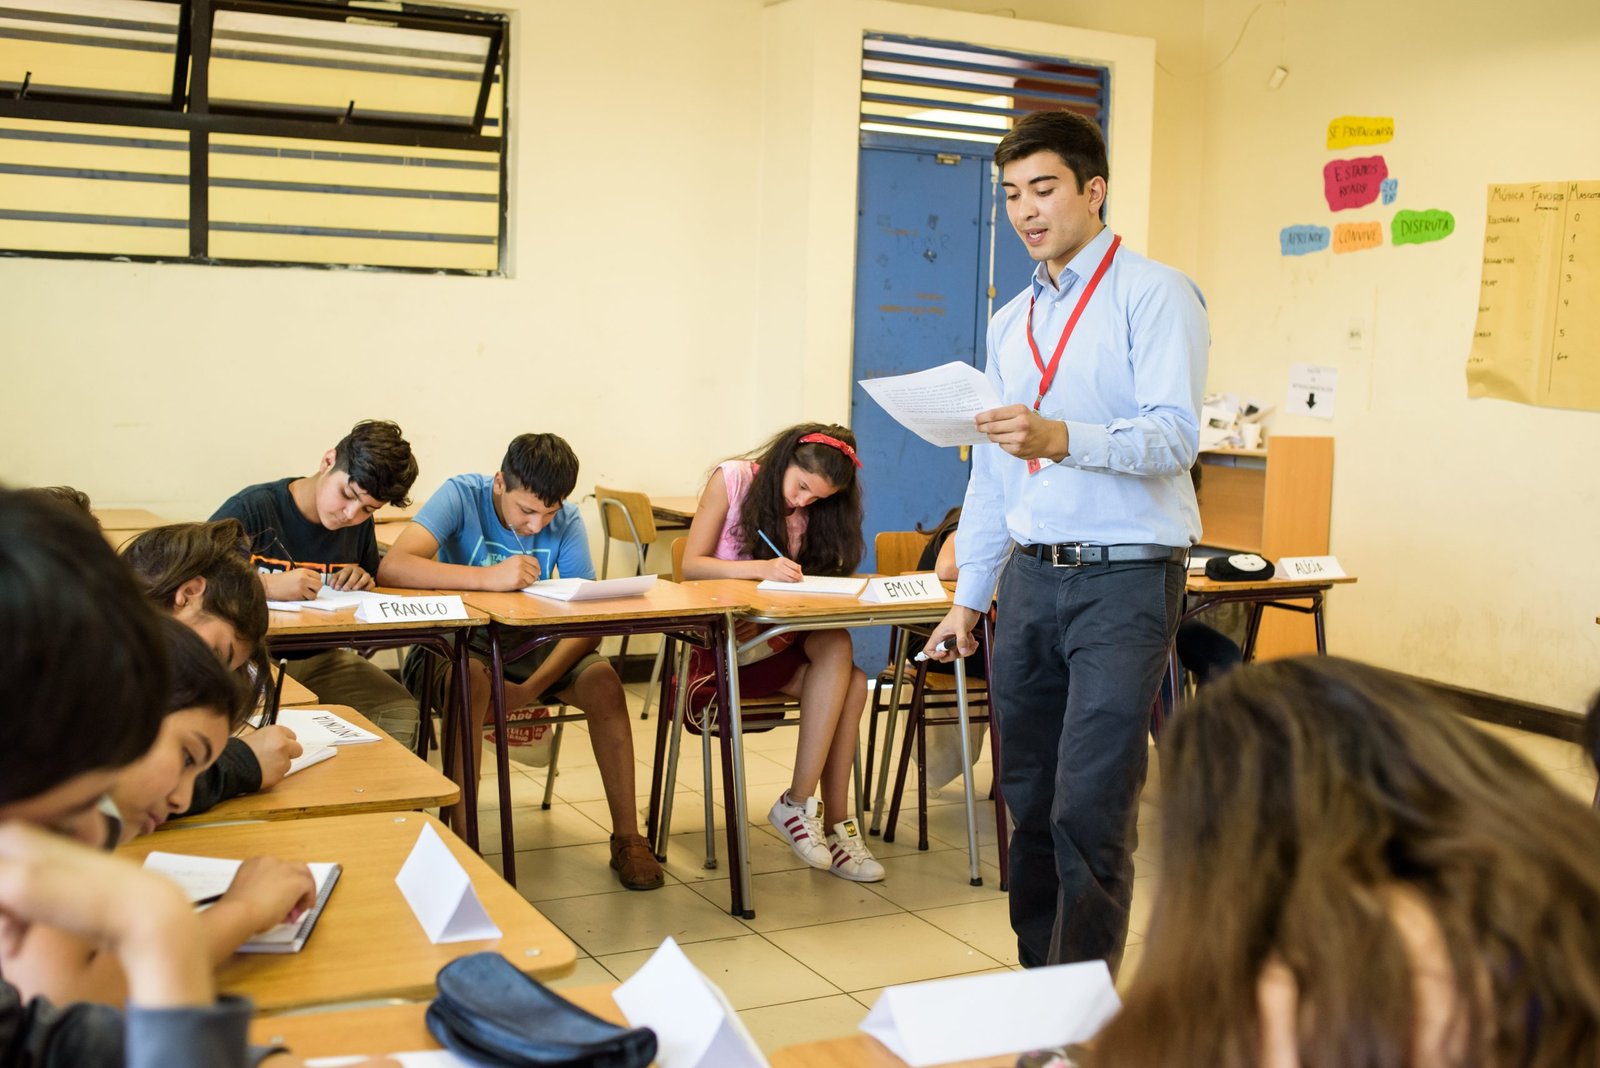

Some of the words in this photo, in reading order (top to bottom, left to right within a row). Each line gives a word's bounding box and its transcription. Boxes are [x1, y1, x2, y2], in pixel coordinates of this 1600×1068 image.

[1400, 218, 1449, 237] DISFRUTA
[1338, 229, 1377, 244] CONVIVE
[1568, 254, 1575, 262] 2
[1566, 274, 1572, 282] 3
[1560, 329, 1566, 337] 5
[884, 580, 928, 598] EMILY
[379, 602, 448, 618] FRANCO
